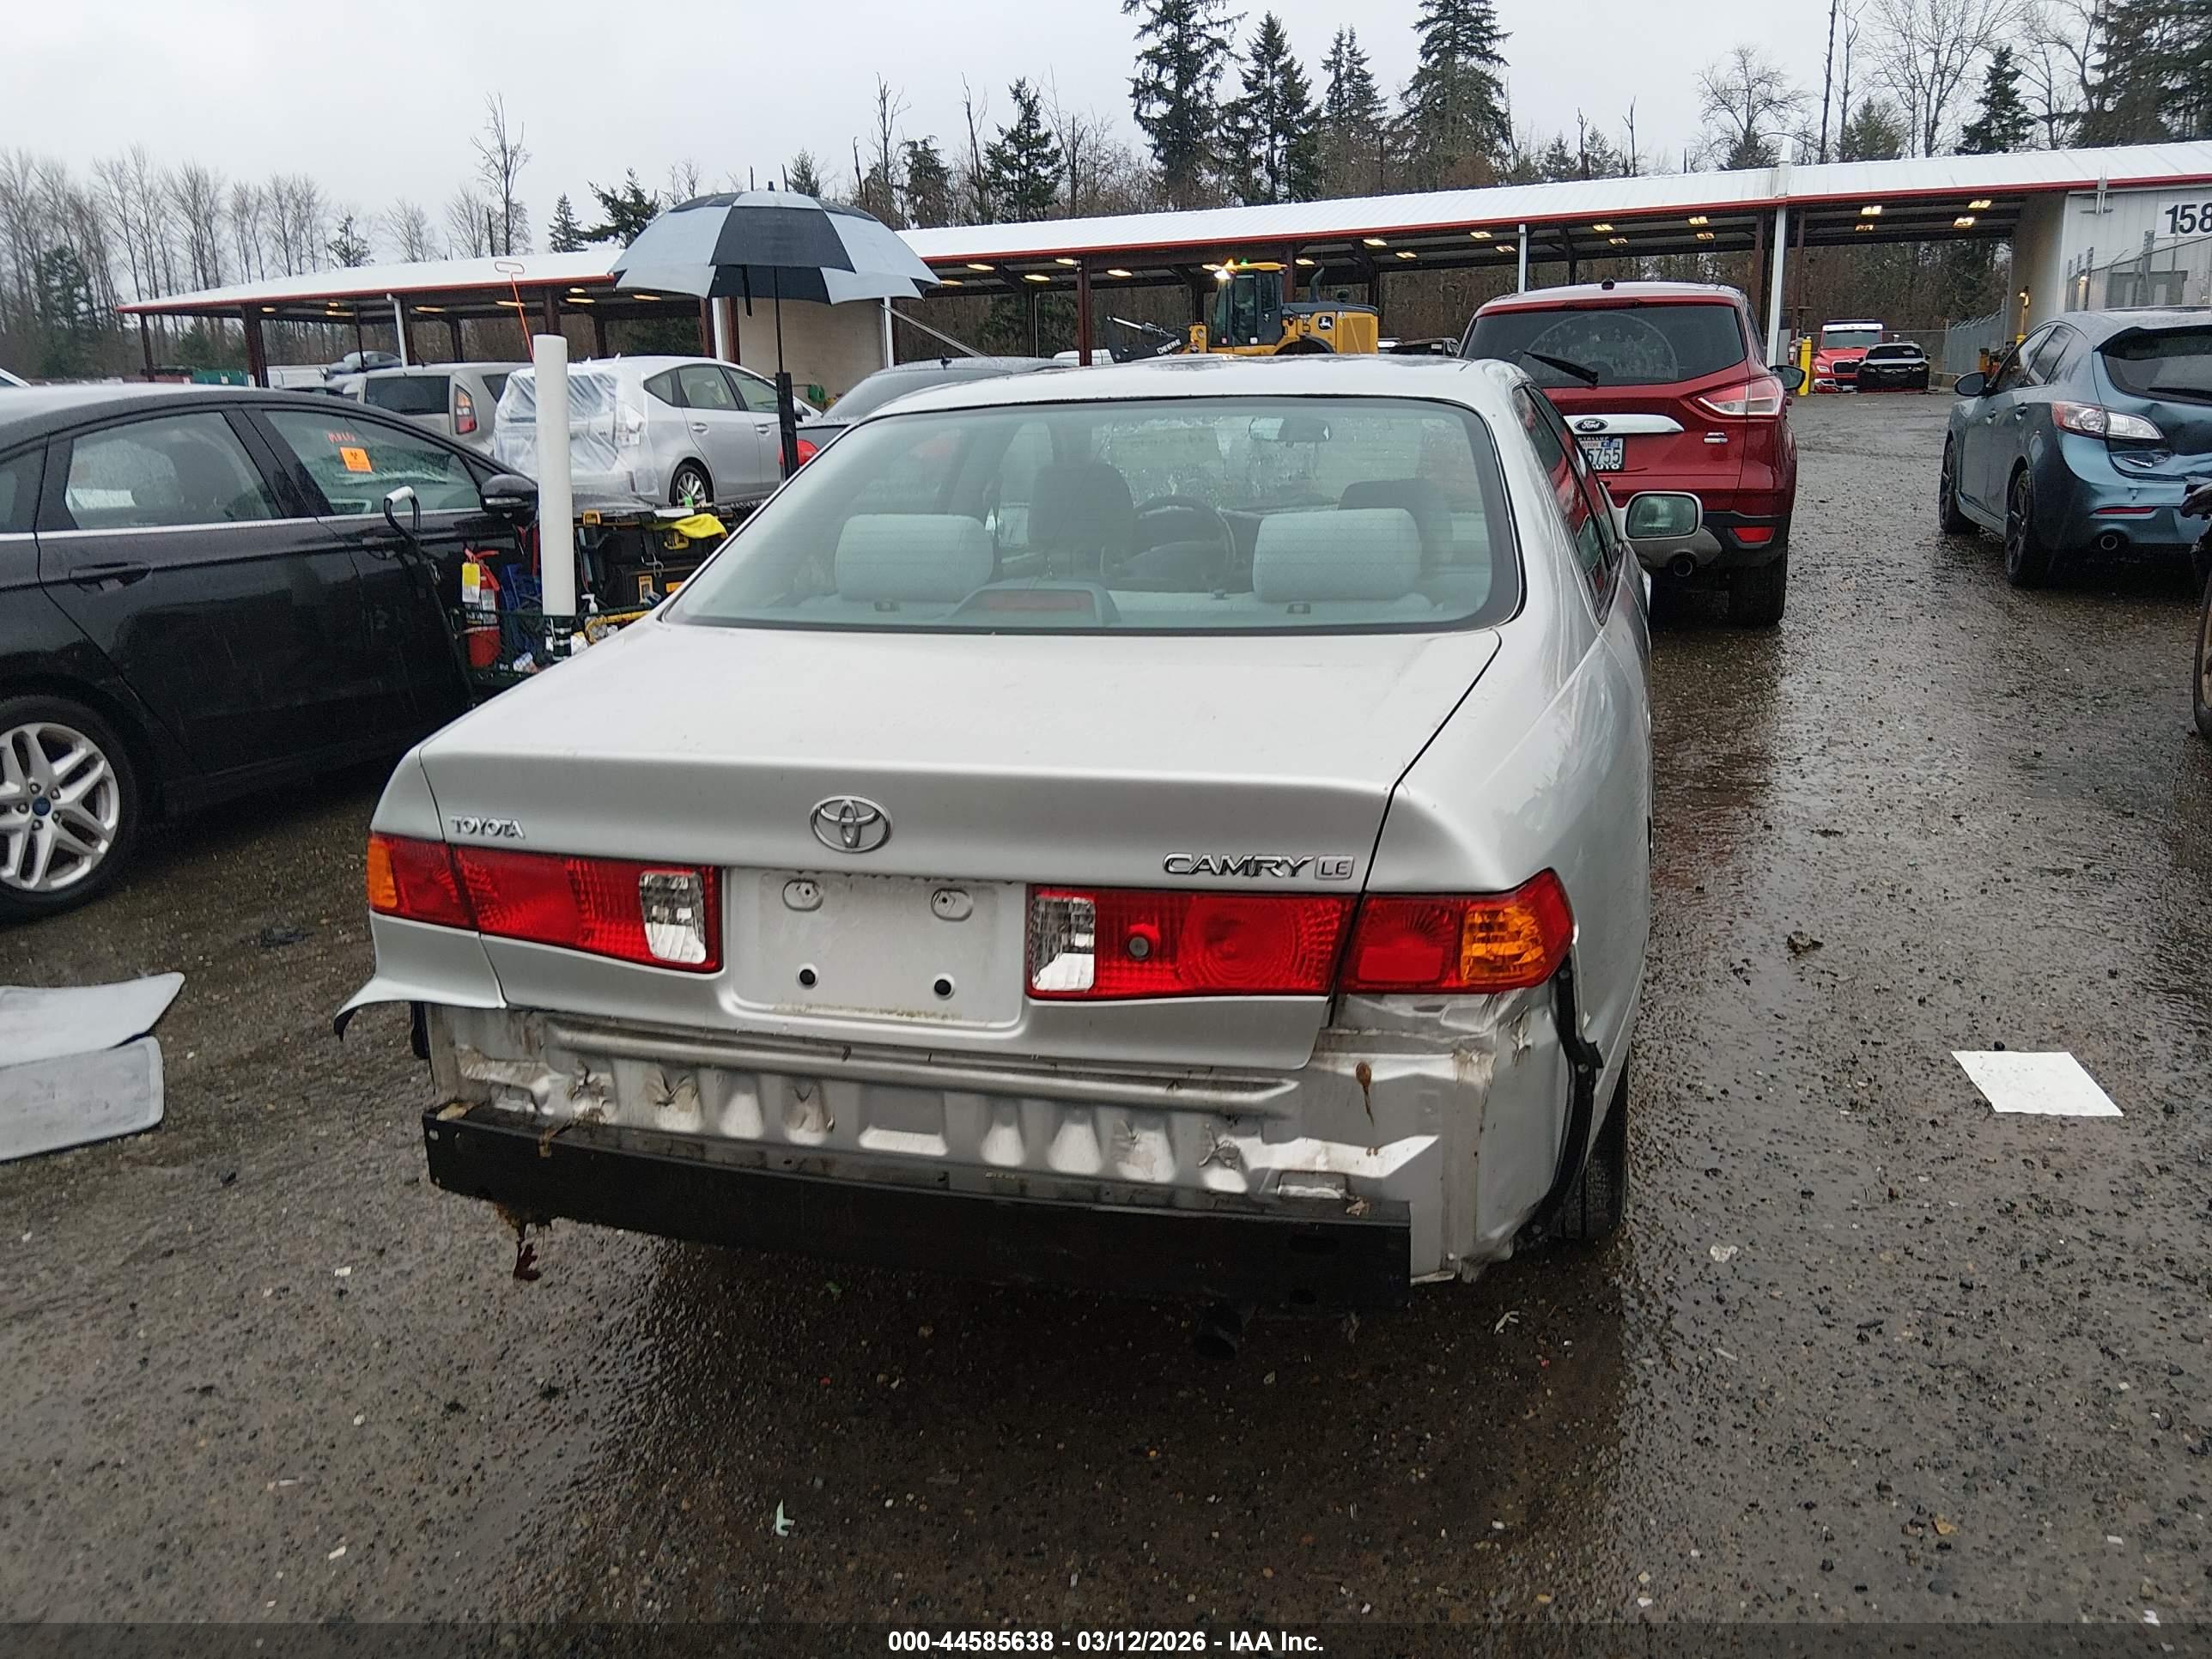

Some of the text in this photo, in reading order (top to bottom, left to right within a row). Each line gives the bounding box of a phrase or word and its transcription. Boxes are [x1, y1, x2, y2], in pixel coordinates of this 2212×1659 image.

[2164, 203, 2212, 234] 158
[450, 816, 526, 840] TOYOTA
[1163, 853, 1314, 878] CAMRY
